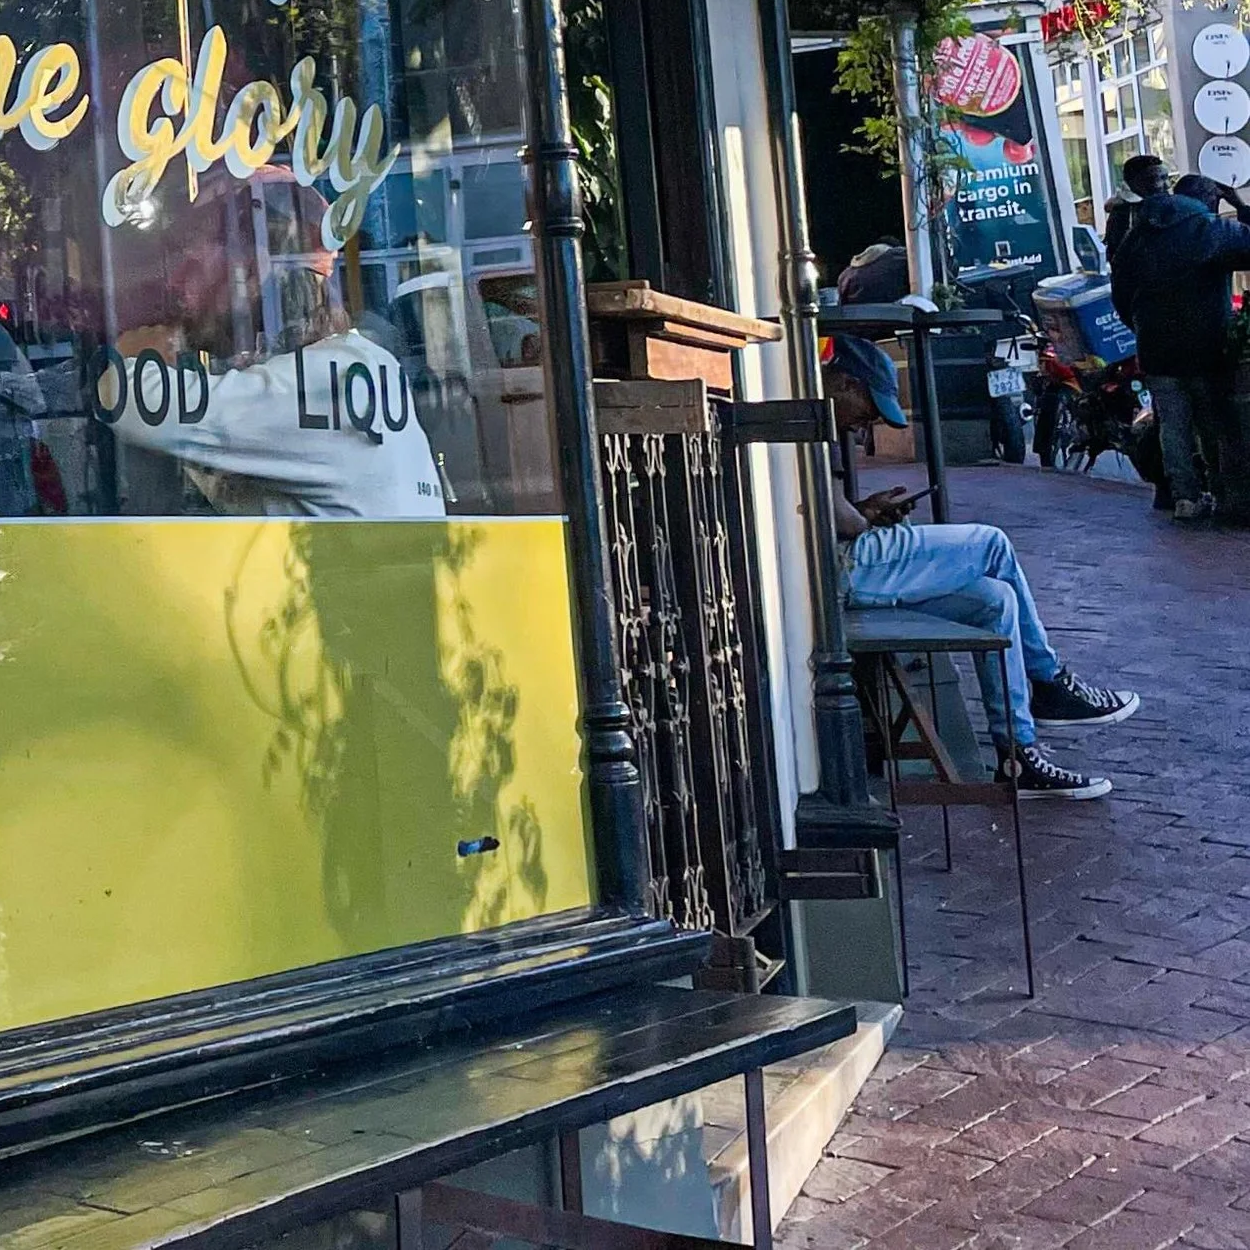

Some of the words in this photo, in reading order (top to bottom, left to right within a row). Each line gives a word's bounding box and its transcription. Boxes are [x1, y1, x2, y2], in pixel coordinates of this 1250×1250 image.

[101, 25, 401, 253] glory
[957, 184, 1009, 203] cargo
[1013, 179, 1032, 195] in
[958, 199, 1027, 222] transit.
[295, 345, 410, 445] LIQU
